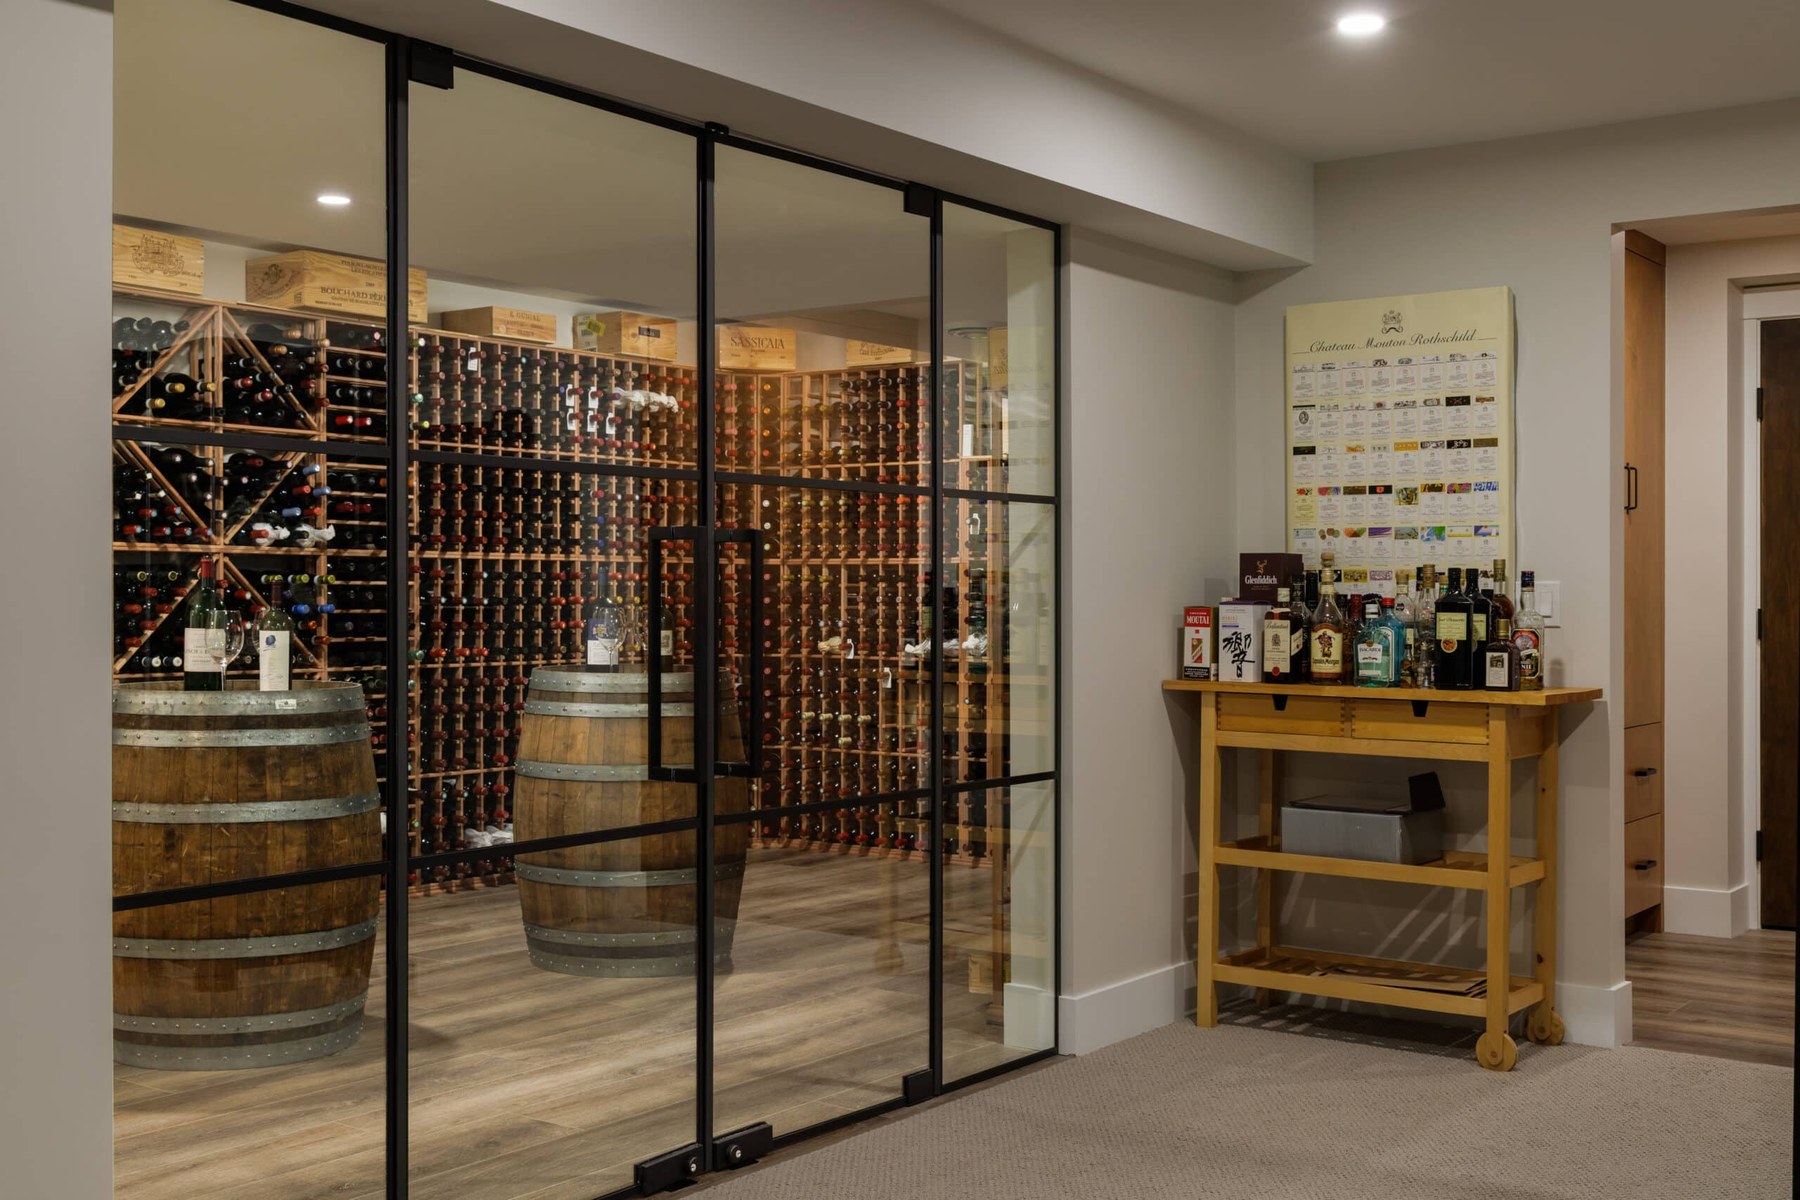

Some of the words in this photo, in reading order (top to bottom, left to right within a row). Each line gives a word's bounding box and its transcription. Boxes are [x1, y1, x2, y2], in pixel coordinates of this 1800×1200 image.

[320, 286, 368, 299] BOUCHARD
[730, 336, 785, 350] SASSICAIA
[1309, 340, 1356, 353] Chateau
[1357, 337, 1406, 349] Mouton
[1406, 329, 1477, 346] Rothschild
[1244, 575, 1278, 585] Glenfiddich
[1186, 615, 1210, 625] MOUTAI
